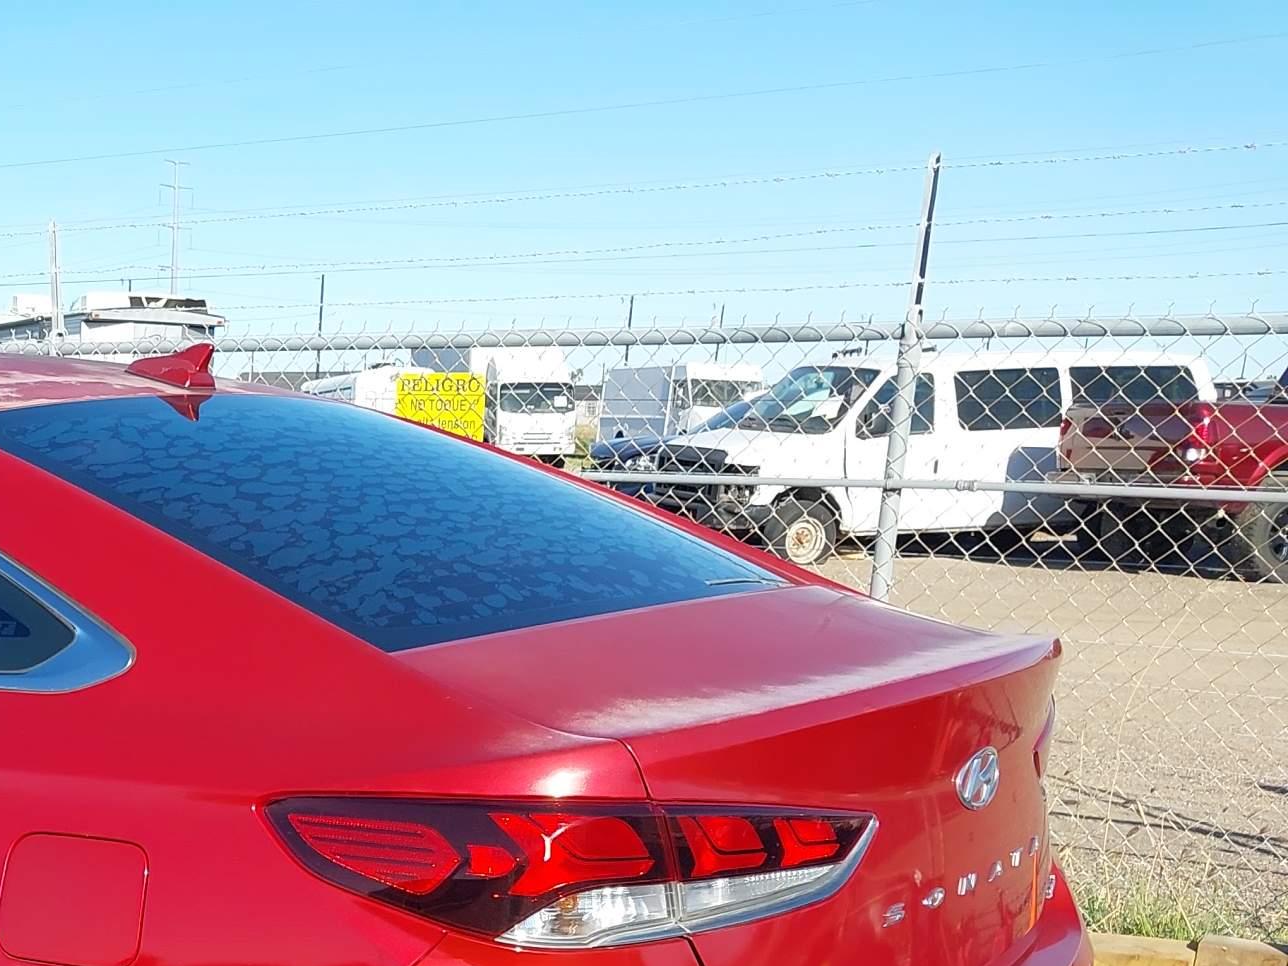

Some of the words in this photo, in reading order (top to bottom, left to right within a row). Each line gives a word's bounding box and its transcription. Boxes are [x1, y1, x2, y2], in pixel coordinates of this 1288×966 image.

[400, 378, 481, 393] PELIGRO
[411, 399, 426, 411] NO
[429, 399, 466, 412] TOQUE
